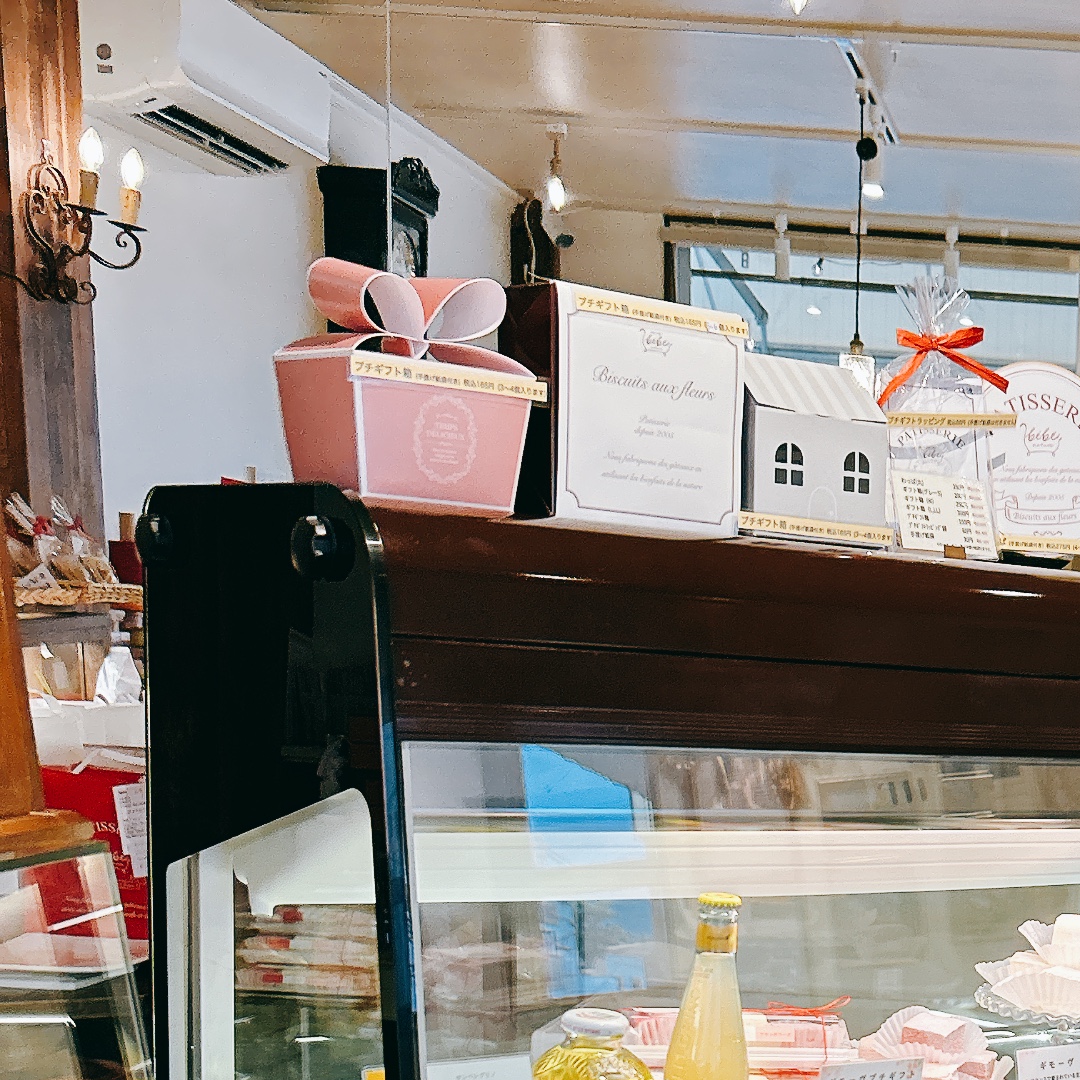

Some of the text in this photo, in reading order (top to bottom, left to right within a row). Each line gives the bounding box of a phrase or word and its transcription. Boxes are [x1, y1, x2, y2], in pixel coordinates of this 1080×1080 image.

[578, 297, 629, 314] プチギフト箱
[355, 361, 412, 379] プチギフト箱
[592, 365, 715, 401] Biscuits aux fleurs
[741, 516, 787, 530] プチギフト箱
[1013, 511, 1041, 522] Biscuits
[1040, 1058, 1074, 1069] ギモーヴ
